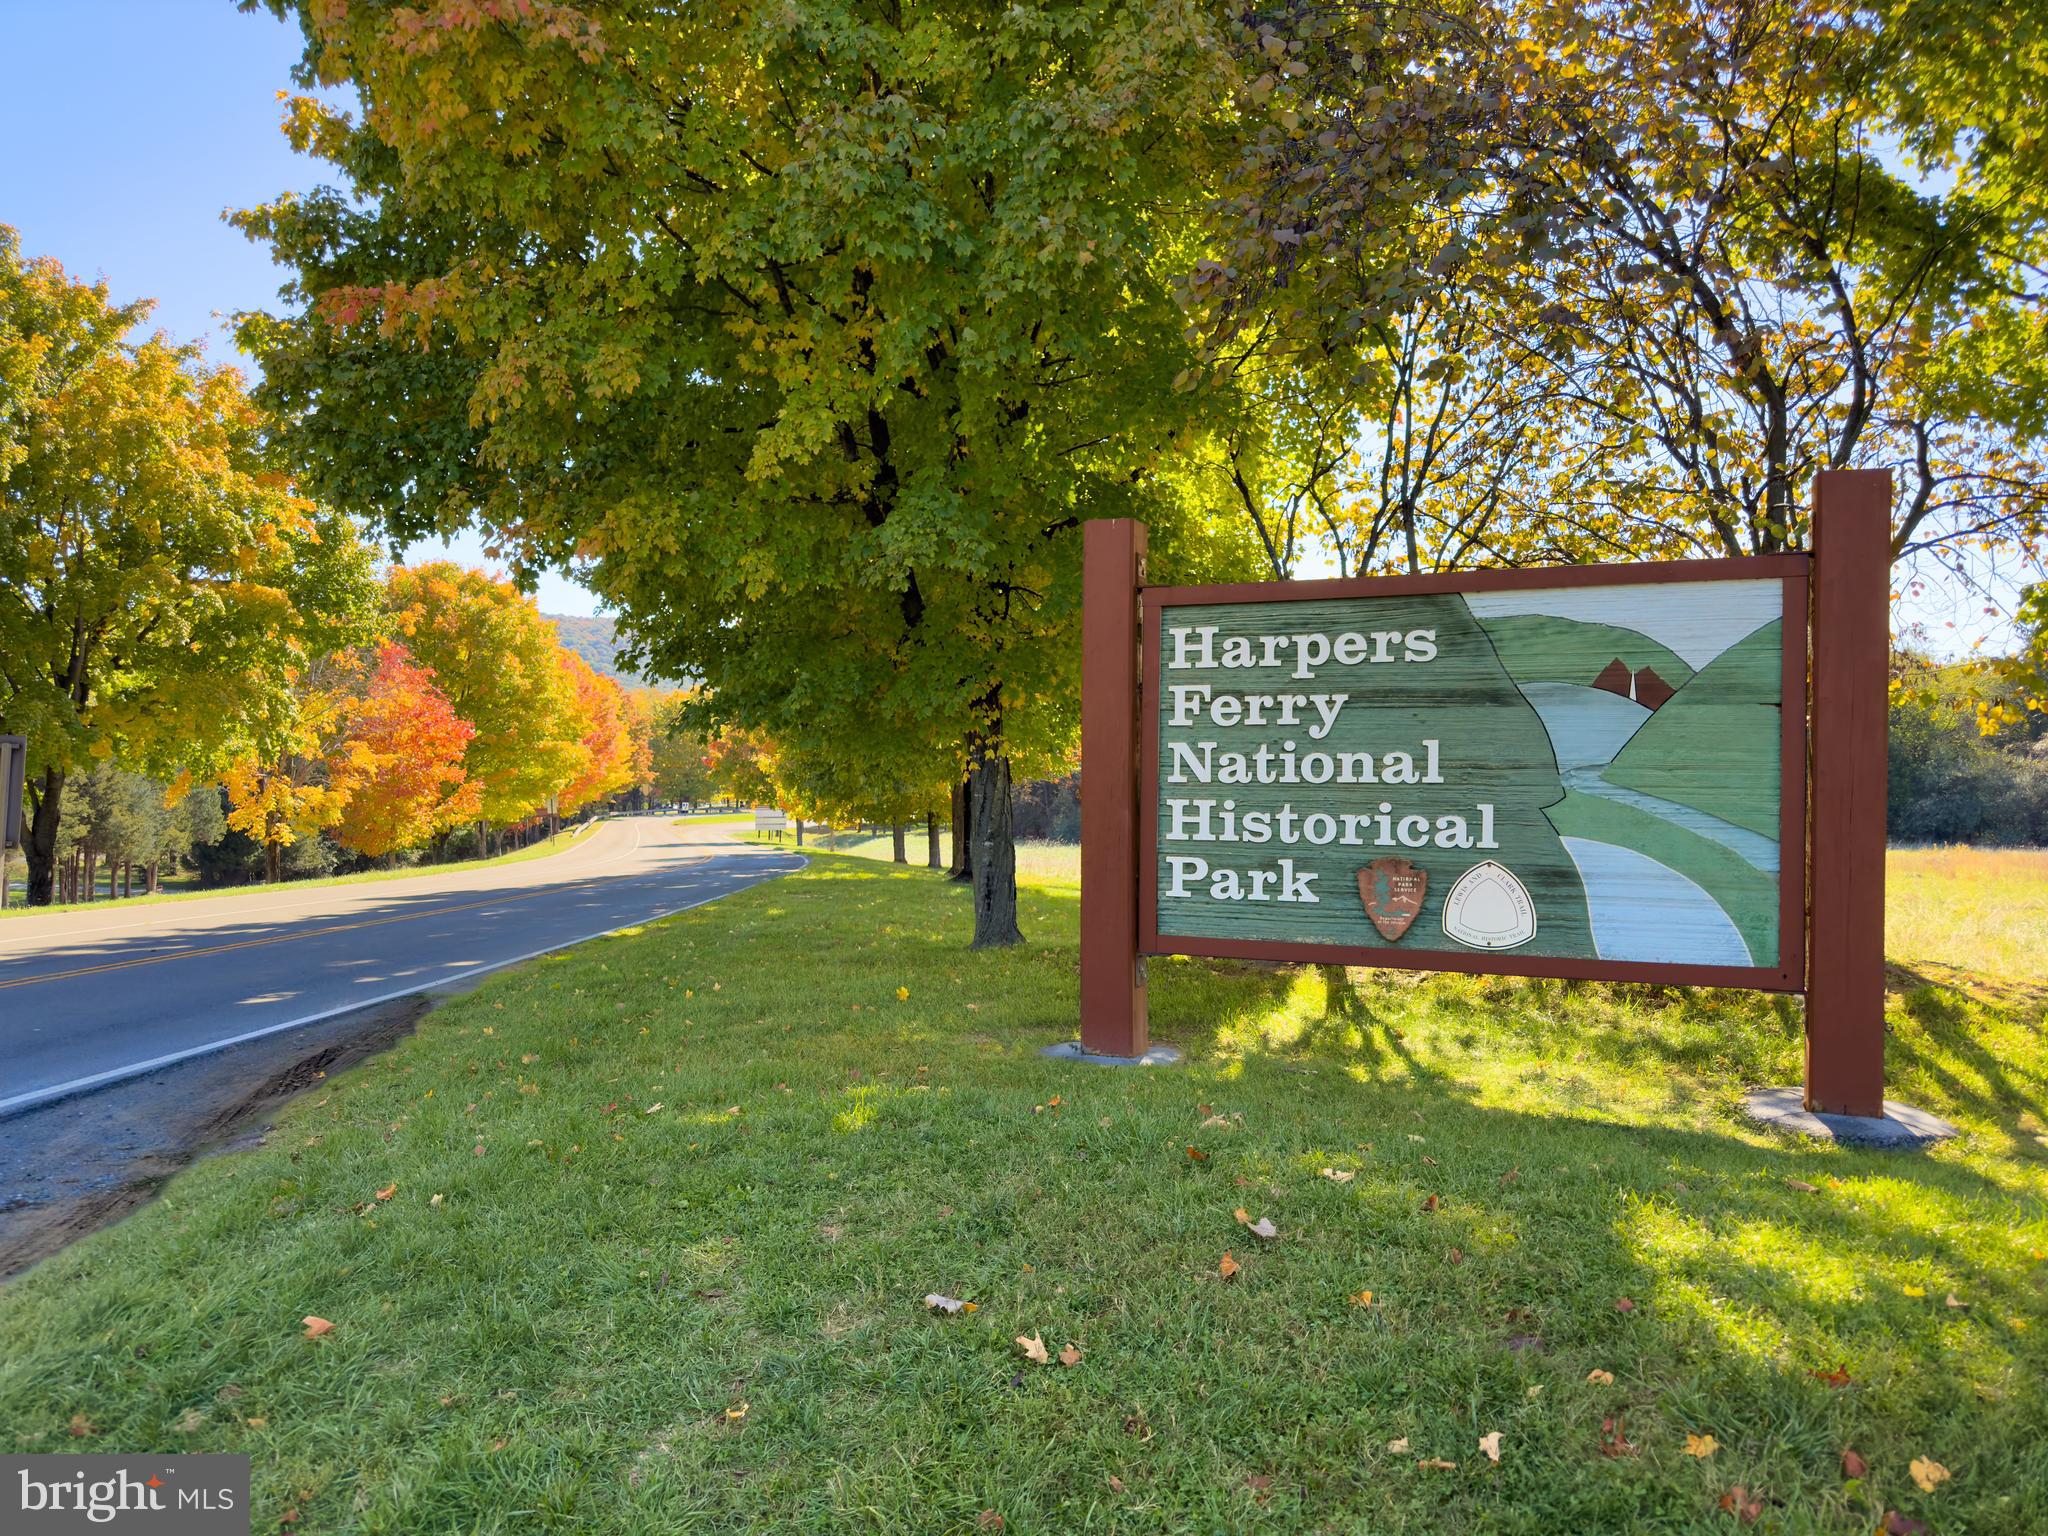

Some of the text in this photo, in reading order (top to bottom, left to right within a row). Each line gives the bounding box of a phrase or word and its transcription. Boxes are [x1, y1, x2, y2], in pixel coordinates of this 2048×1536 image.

[1168, 626, 1438, 679] Harpers
[1168, 684, 1349, 739] Ferry
[1167, 739, 1445, 784] National
[1165, 799, 1499, 849] Historical
[1165, 856, 1320, 903] Park
[1453, 872, 1528, 917] LEWIS AND CLARK TRAIL
